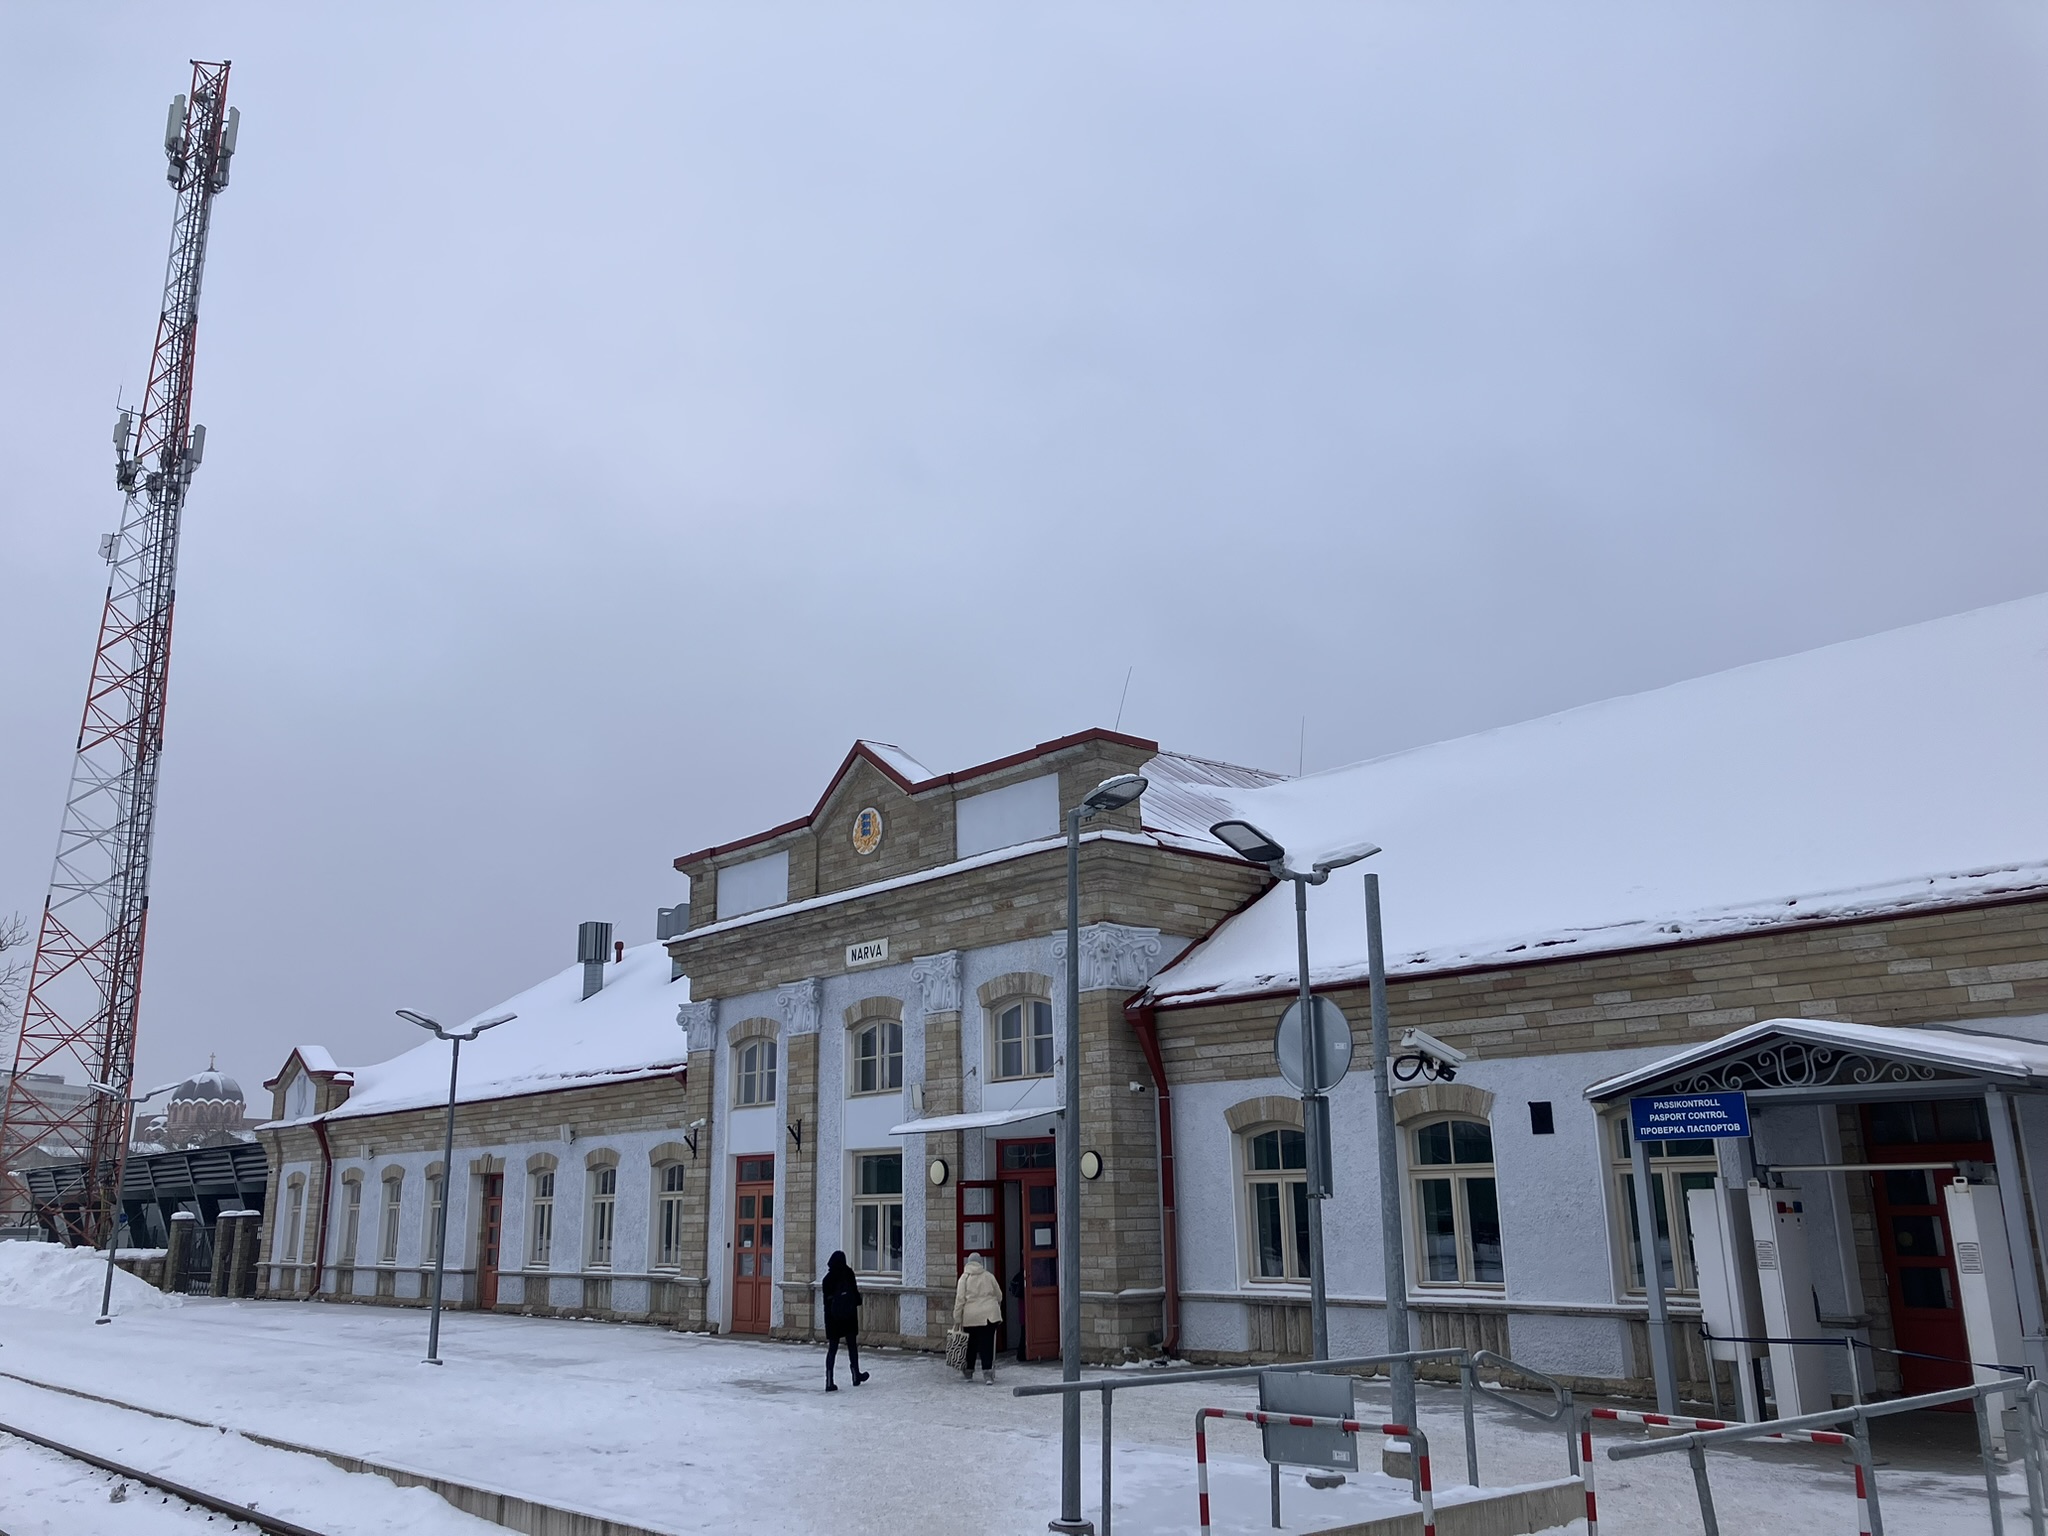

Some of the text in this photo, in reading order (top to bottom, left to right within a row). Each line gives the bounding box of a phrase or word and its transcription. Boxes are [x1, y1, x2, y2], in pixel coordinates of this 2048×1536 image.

[851, 944, 882, 962] NARVA
[1653, 1098, 1720, 1109] PASSIKONTROLL
[1649, 1110, 1728, 1122] PASPORT CONTROL
[1640, 1123, 1740, 1135] ПРОВЕРКА ПАСПОРТОВ
